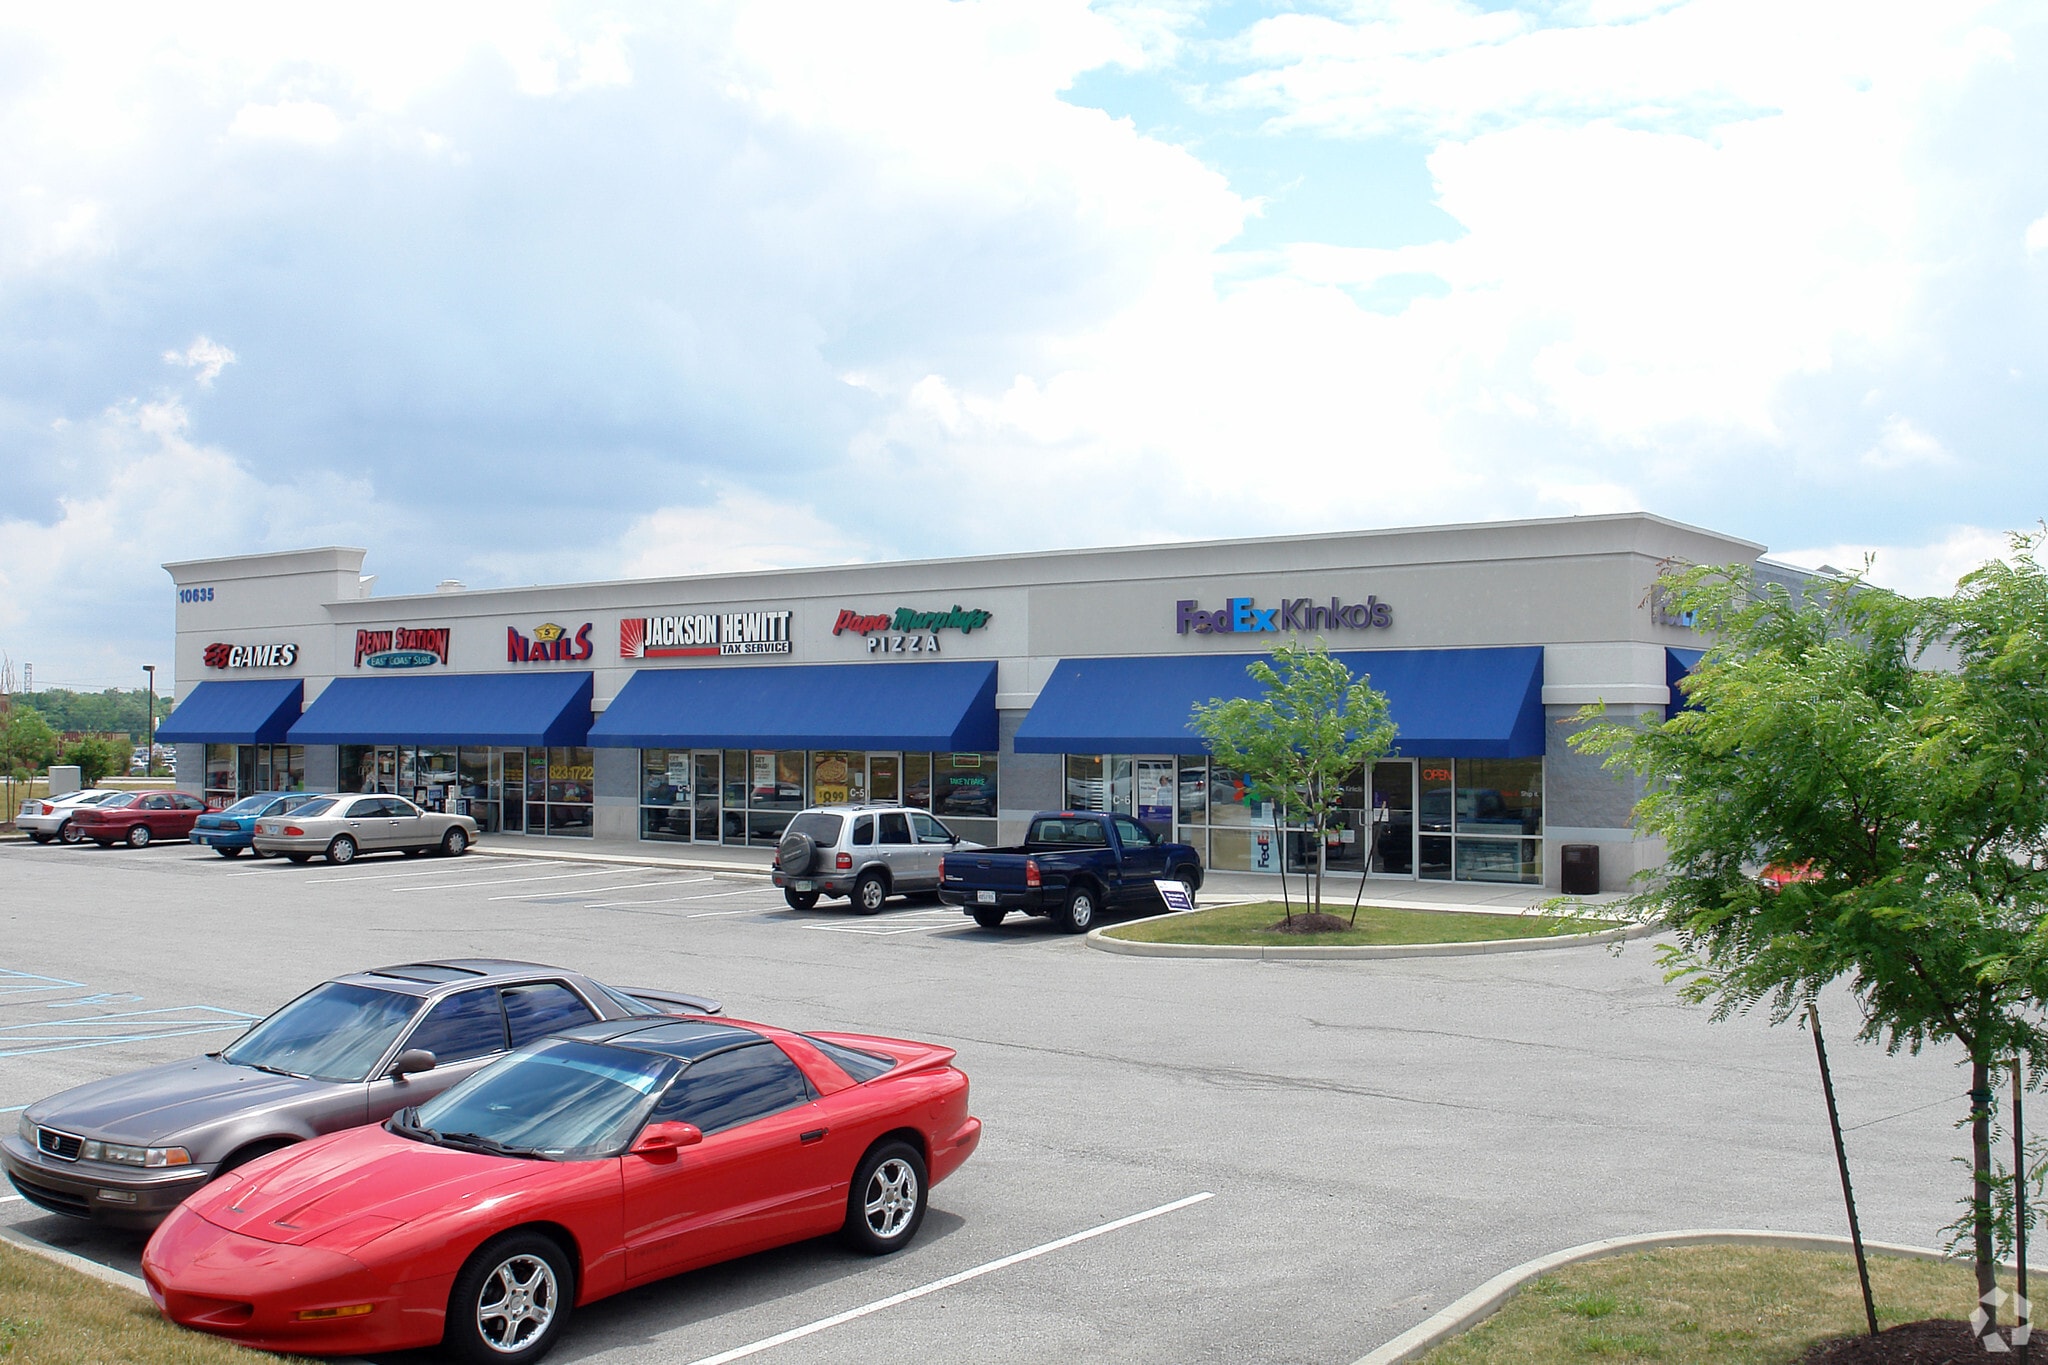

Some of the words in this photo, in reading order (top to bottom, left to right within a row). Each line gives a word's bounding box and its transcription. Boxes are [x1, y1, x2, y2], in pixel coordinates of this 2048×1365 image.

[179, 587, 214, 603] 10635
[832, 608, 892, 636] Papa
[891, 604, 992, 635] Murphy's
[1176, 597, 1278, 635] FedEx
[1281, 595, 1392, 632] Kinko's
[644, 615, 720, 646] JACKSON
[721, 611, 793, 643] HEWITT
[354, 629, 393, 667] PENN
[395, 626, 450, 665] STATION
[507, 622, 593, 663] NAILS
[722, 644, 744, 654] TAX
[745, 642, 789, 653] SERVICE
[867, 635, 941, 652] PIZZA
[203, 642, 232, 669] EB
[228, 643, 299, 668] GAMES
[370, 656, 387, 666] EAST
[389, 655, 411, 665] COAST
[1423, 768, 1452, 781] OPEN
[850, 787, 865, 797] C-5
[1113, 795, 1131, 805] C-6
